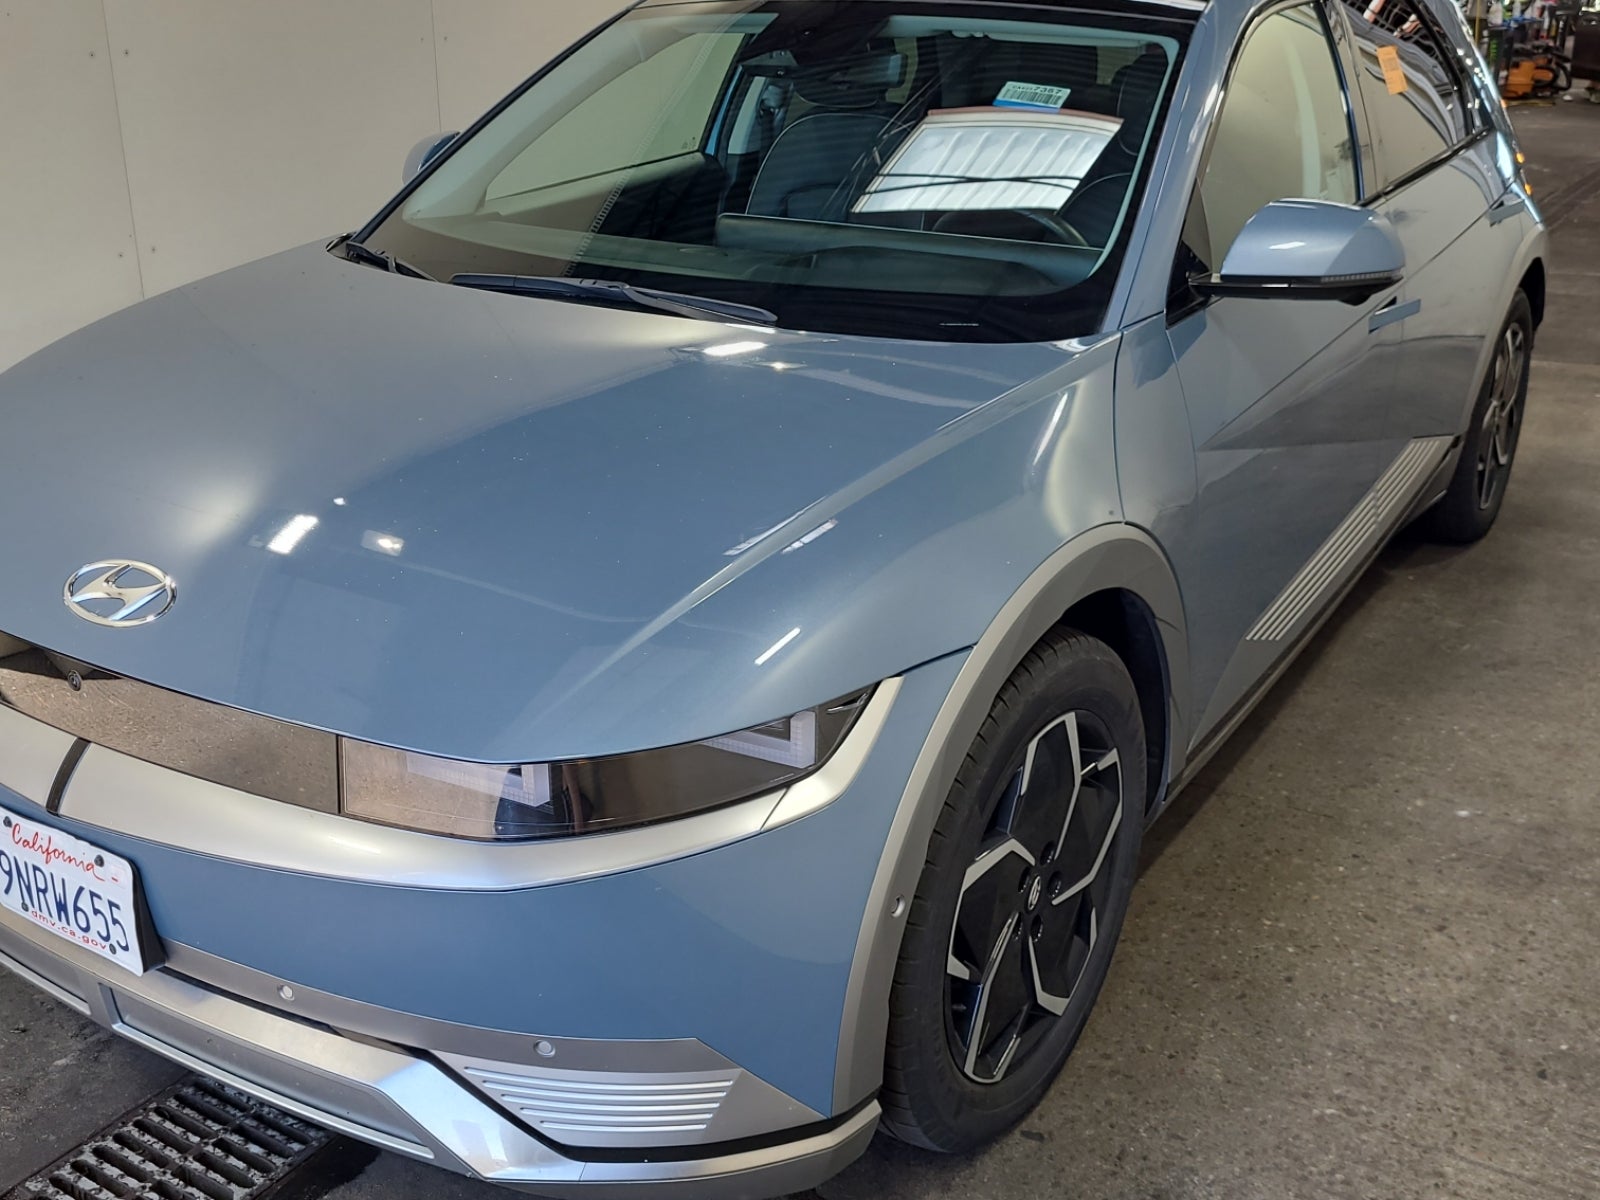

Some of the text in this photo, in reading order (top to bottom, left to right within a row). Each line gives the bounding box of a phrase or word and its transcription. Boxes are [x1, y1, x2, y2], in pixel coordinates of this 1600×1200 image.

[12, 823, 105, 881] California
[0, 851, 130, 952] 9NRW655
[31, 910, 107, 949] dmv.ca.gov
